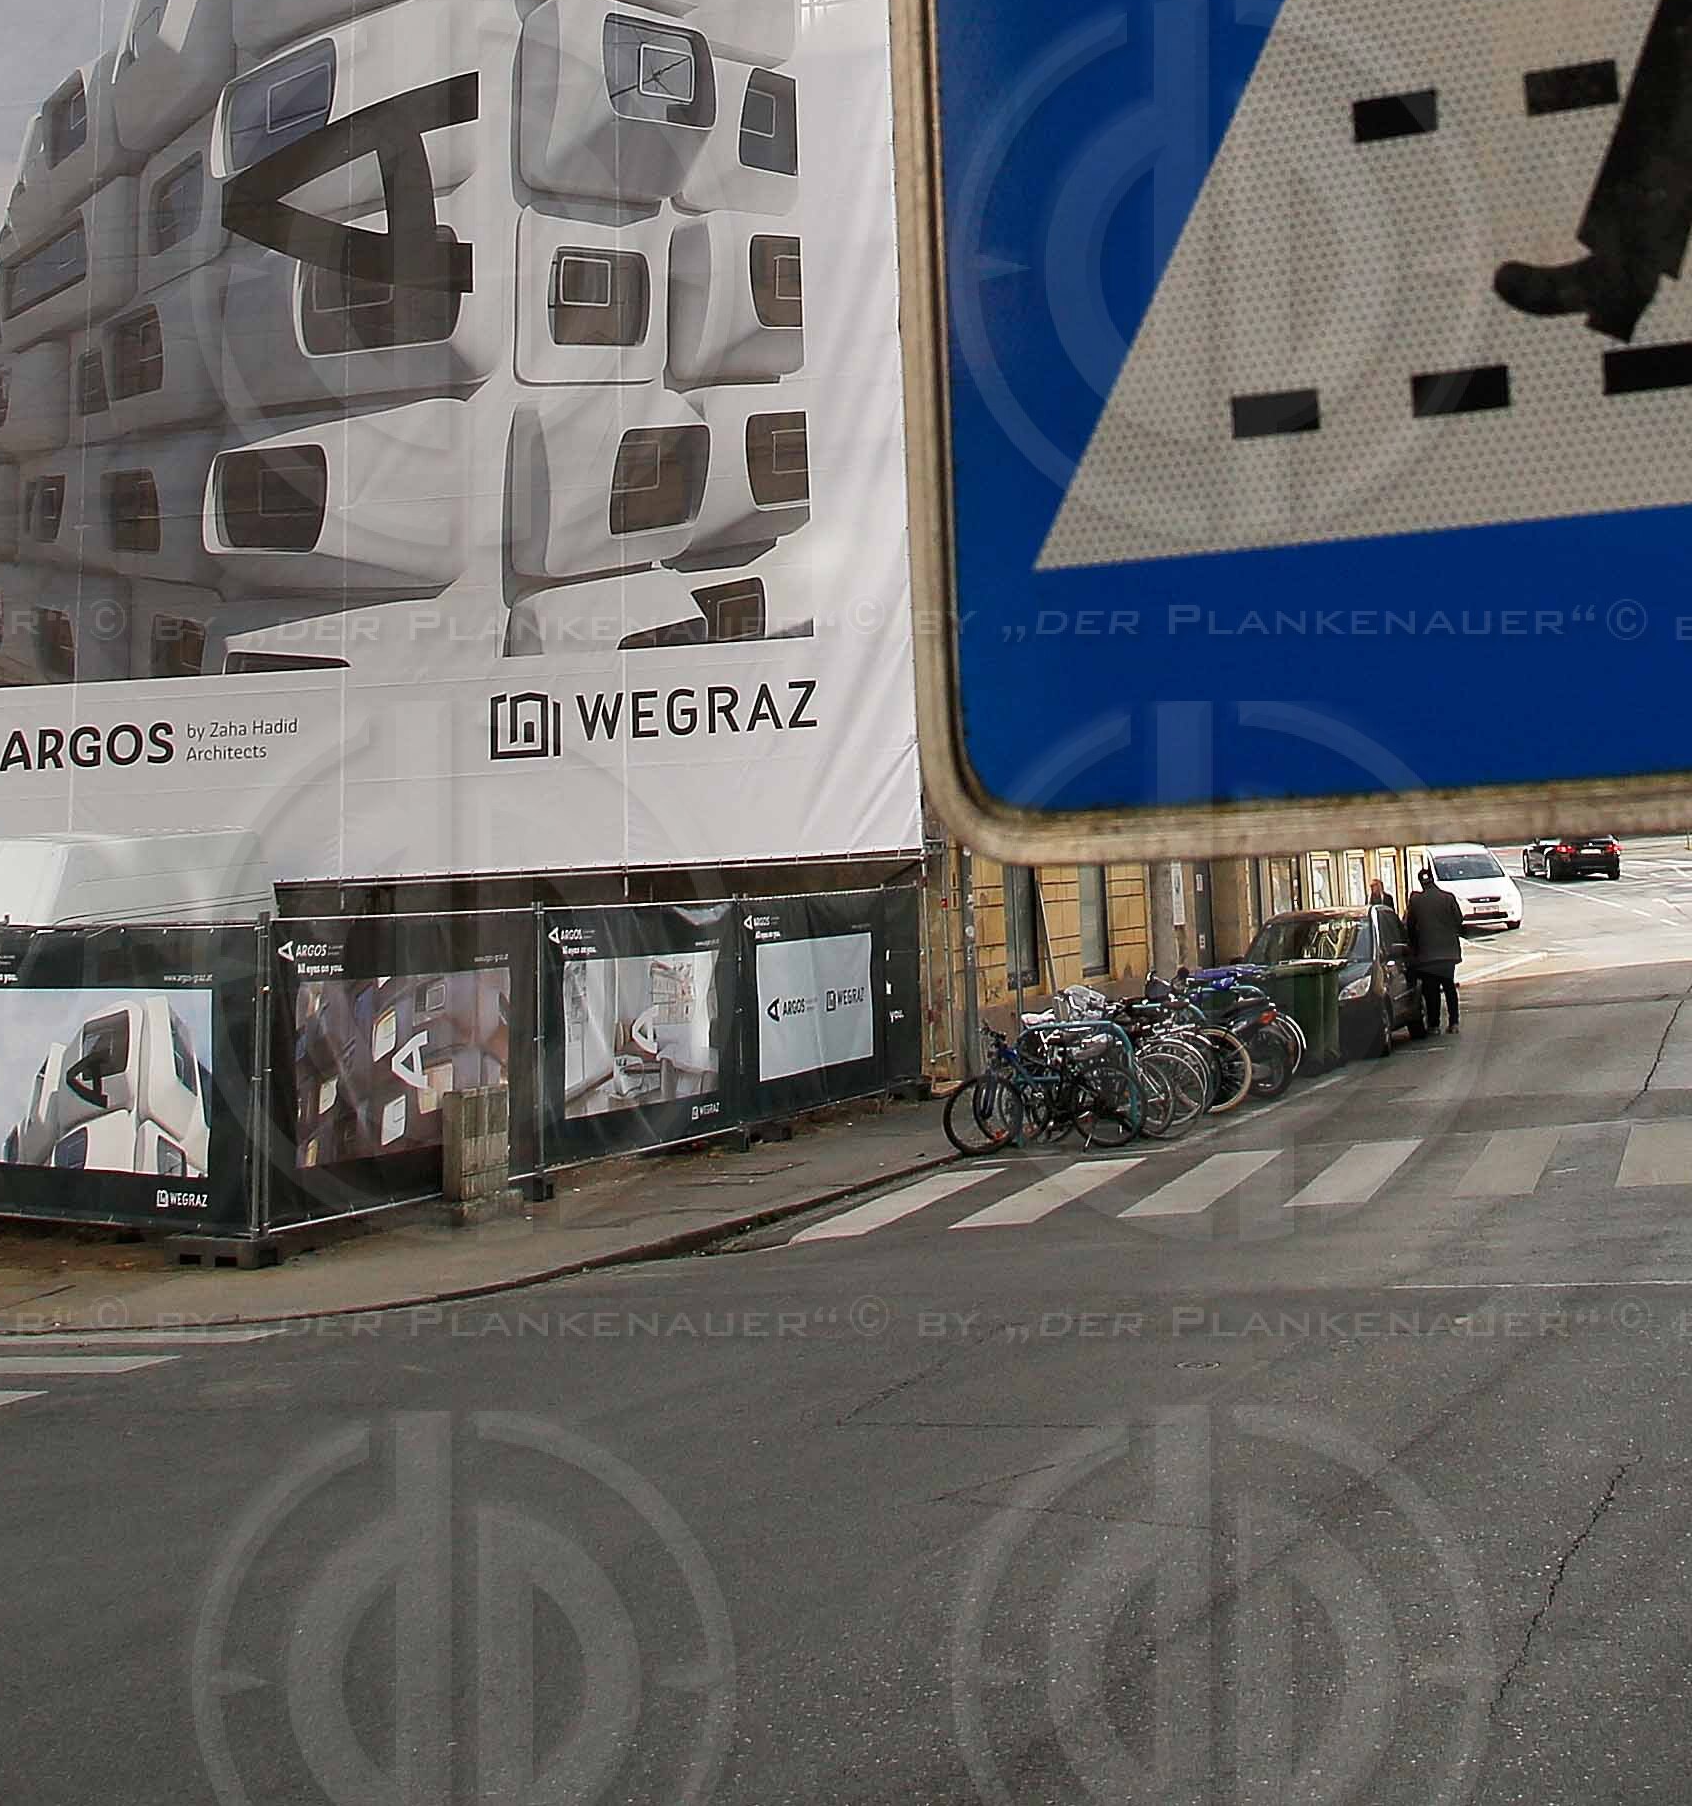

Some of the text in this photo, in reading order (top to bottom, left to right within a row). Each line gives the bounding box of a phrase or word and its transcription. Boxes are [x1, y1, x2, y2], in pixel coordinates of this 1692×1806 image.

[575, 680, 817, 741] WEGRAZ
[186, 718, 298, 740] by Zaha Hadid
[0, 722, 174, 772] ARGOS
[186, 743, 267, 762] Architects
[296, 944, 327, 957] ARGOS
[170, 1192, 208, 1207] WEGRAZ
